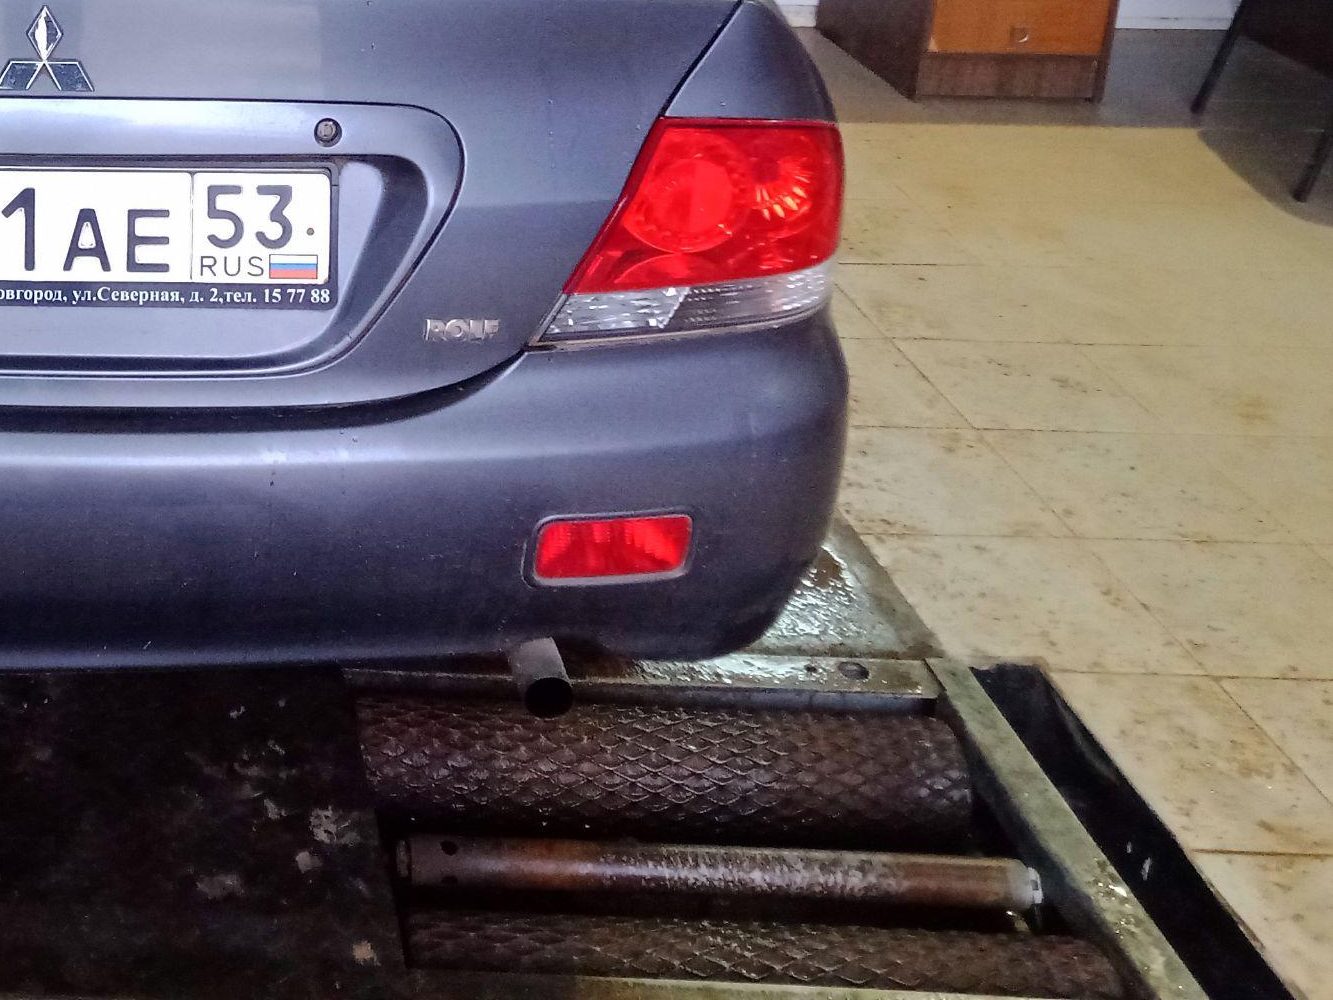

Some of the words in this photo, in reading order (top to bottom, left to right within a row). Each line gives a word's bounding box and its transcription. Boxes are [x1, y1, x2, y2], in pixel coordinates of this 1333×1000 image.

[206, 184, 294, 250] 53
[199, 255, 265, 278] RUS
[189, 291, 204, 303] д.
[264, 288, 282, 304] 15
[286, 288, 306, 304] 77
[310, 288, 331, 304] 88
